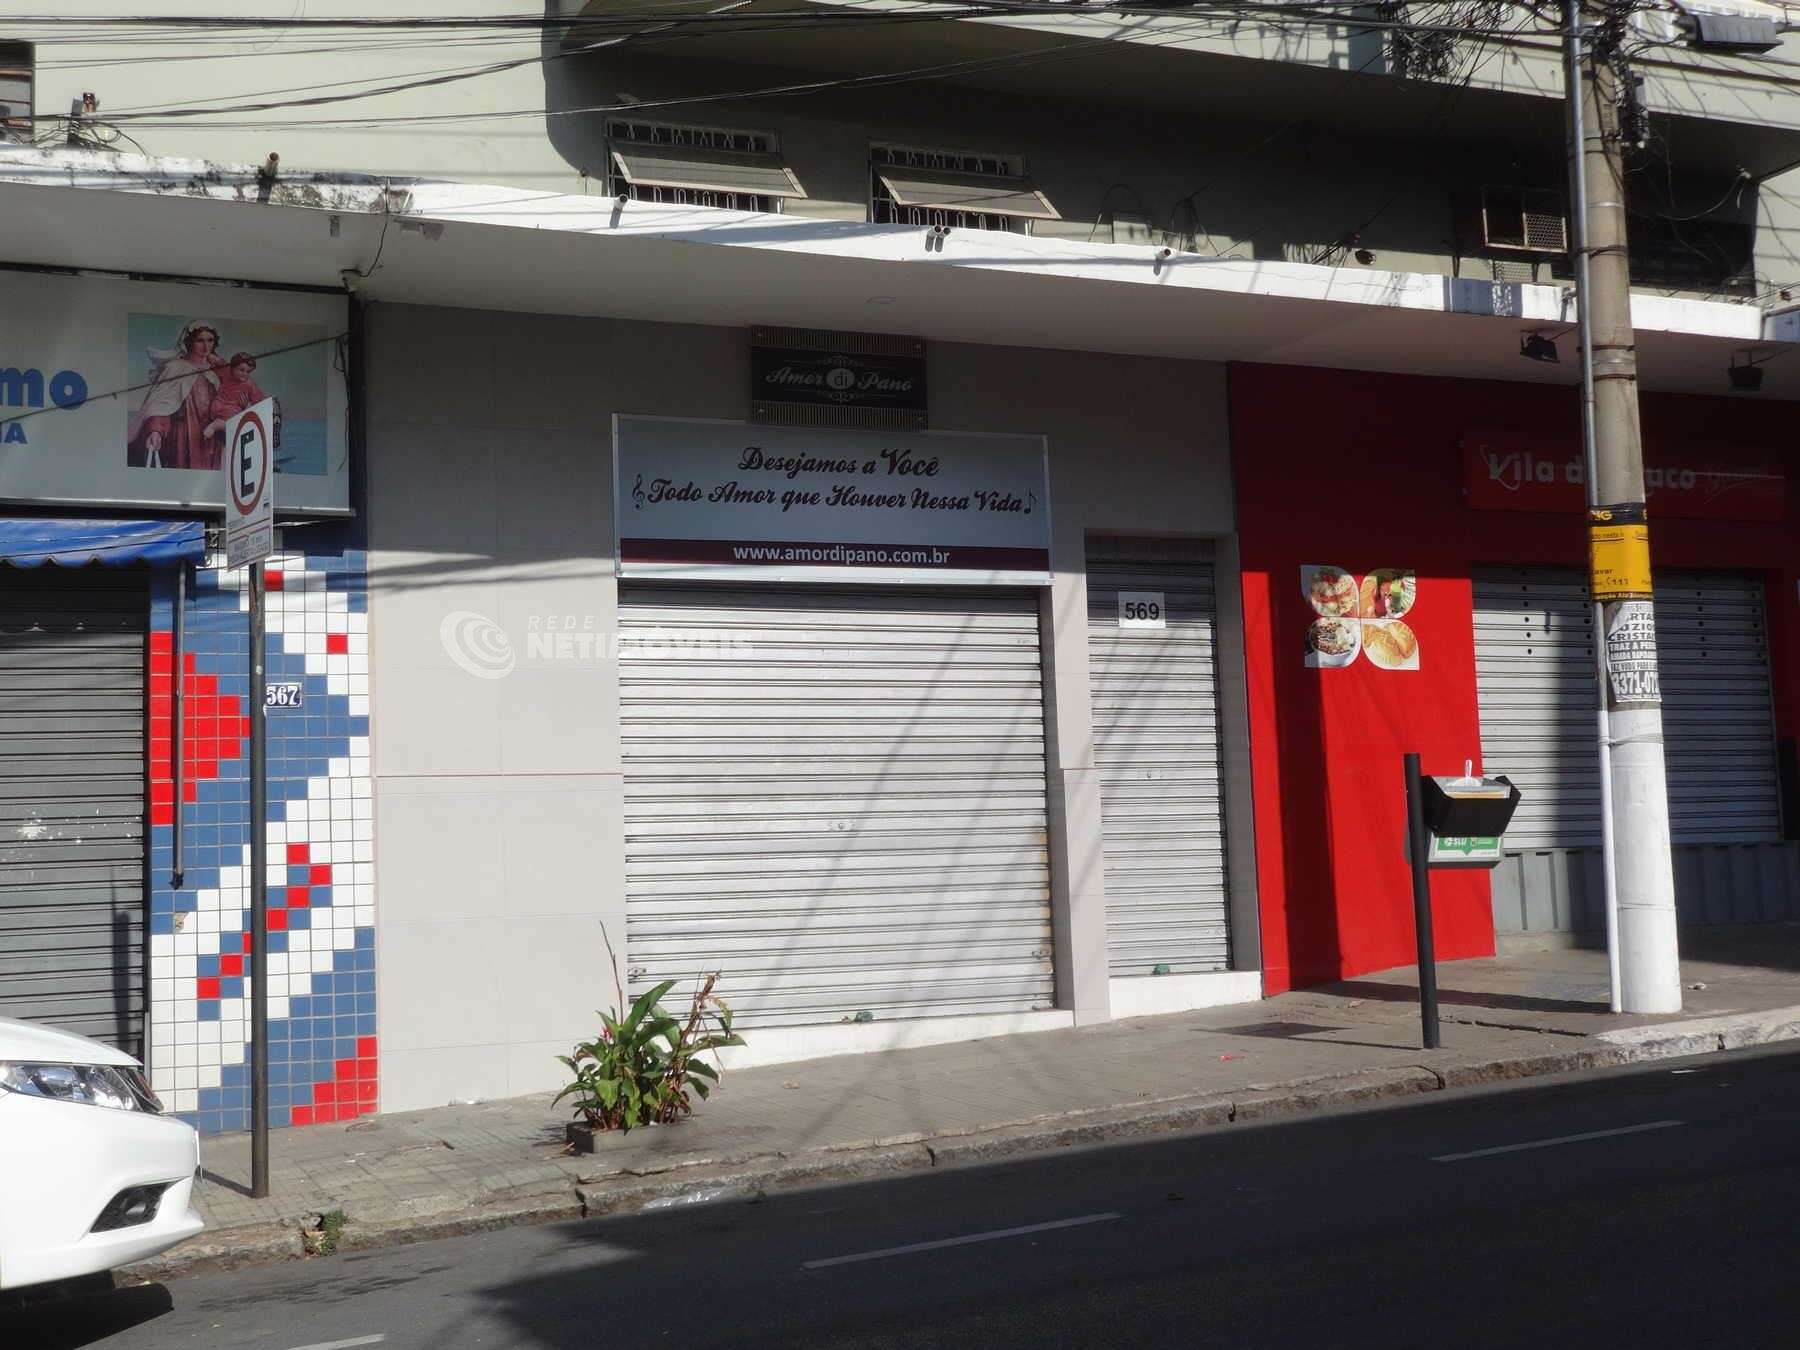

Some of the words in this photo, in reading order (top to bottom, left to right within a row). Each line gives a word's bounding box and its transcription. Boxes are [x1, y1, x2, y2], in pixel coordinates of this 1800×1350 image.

[765, 367, 824, 385] Amor
[857, 371, 913, 392] Pano
[240, 429, 255, 498] E
[738, 447, 857, 479] Desejamos
[862, 463, 877, 475] a
[881, 448, 940, 477] Você
[1484, 448, 1554, 487] Vila
[648, 478, 704, 504] Todo
[708, 481, 777, 504] Amor
[781, 490, 822, 513] que
[826, 485, 907, 509] Houver
[911, 487, 970, 511] Nessa
[974, 490, 1023, 513] Vida
[733, 545, 951, 565] www.amordipano.com.br
[1125, 602, 1160, 620] 569
[266, 685, 298, 705] 567
